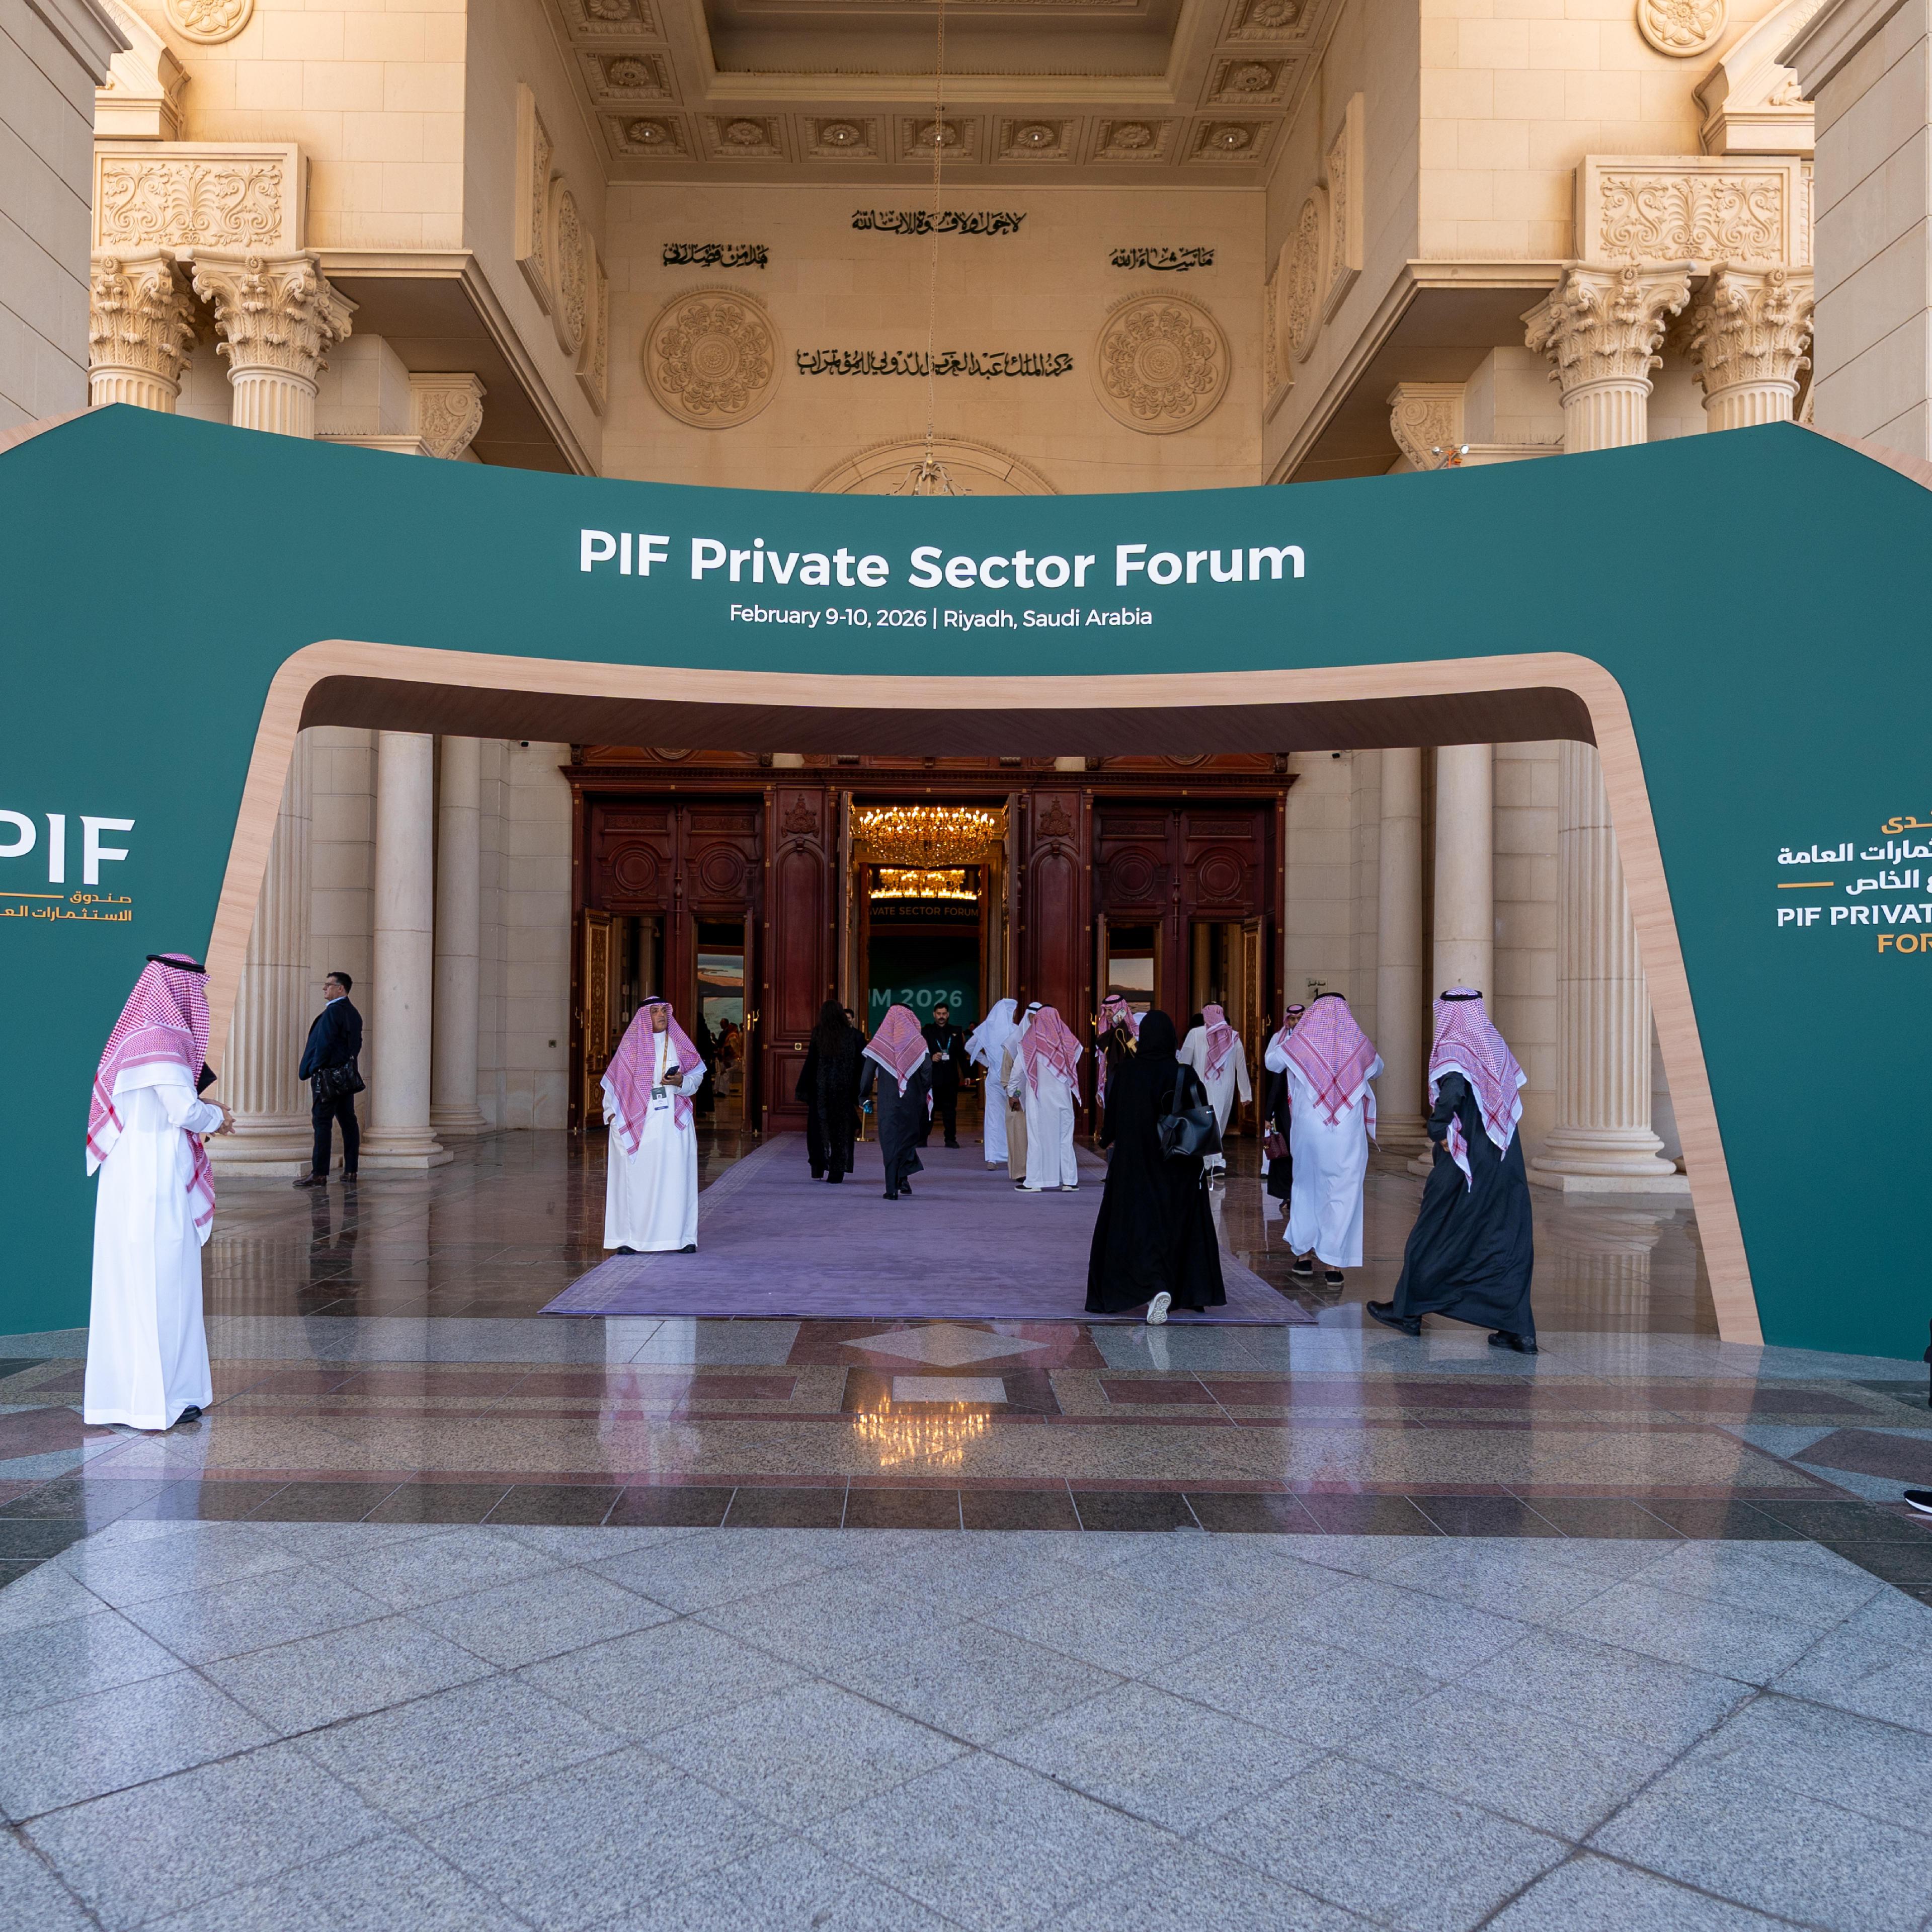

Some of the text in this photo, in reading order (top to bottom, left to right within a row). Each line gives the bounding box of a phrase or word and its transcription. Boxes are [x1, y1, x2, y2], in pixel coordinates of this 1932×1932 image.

[580, 529, 1305, 589] PIF Private Sector Forum
[731, 604, 821, 628] February
[826, 608, 872, 628] 9-10,
[876, 609, 927, 627] 2026
[944, 609, 1017, 631] Riyadh,
[1022, 609, 1080, 627] Saudi
[1085, 607, 1152, 626] Arabia
[0, 810, 135, 885] PIF
[1778, 843, 1854, 864] العامة
[1845, 869, 1919, 895] الخاص
[69, 891, 132, 905] صندوق
[32, 907, 132, 921] الاستثمارات
[899, 907, 941, 915] SECTOR
[944, 907, 979, 917] FORUM
[1777, 907, 1822, 927] PIF
[868, 988, 962, 1008] M 2026
